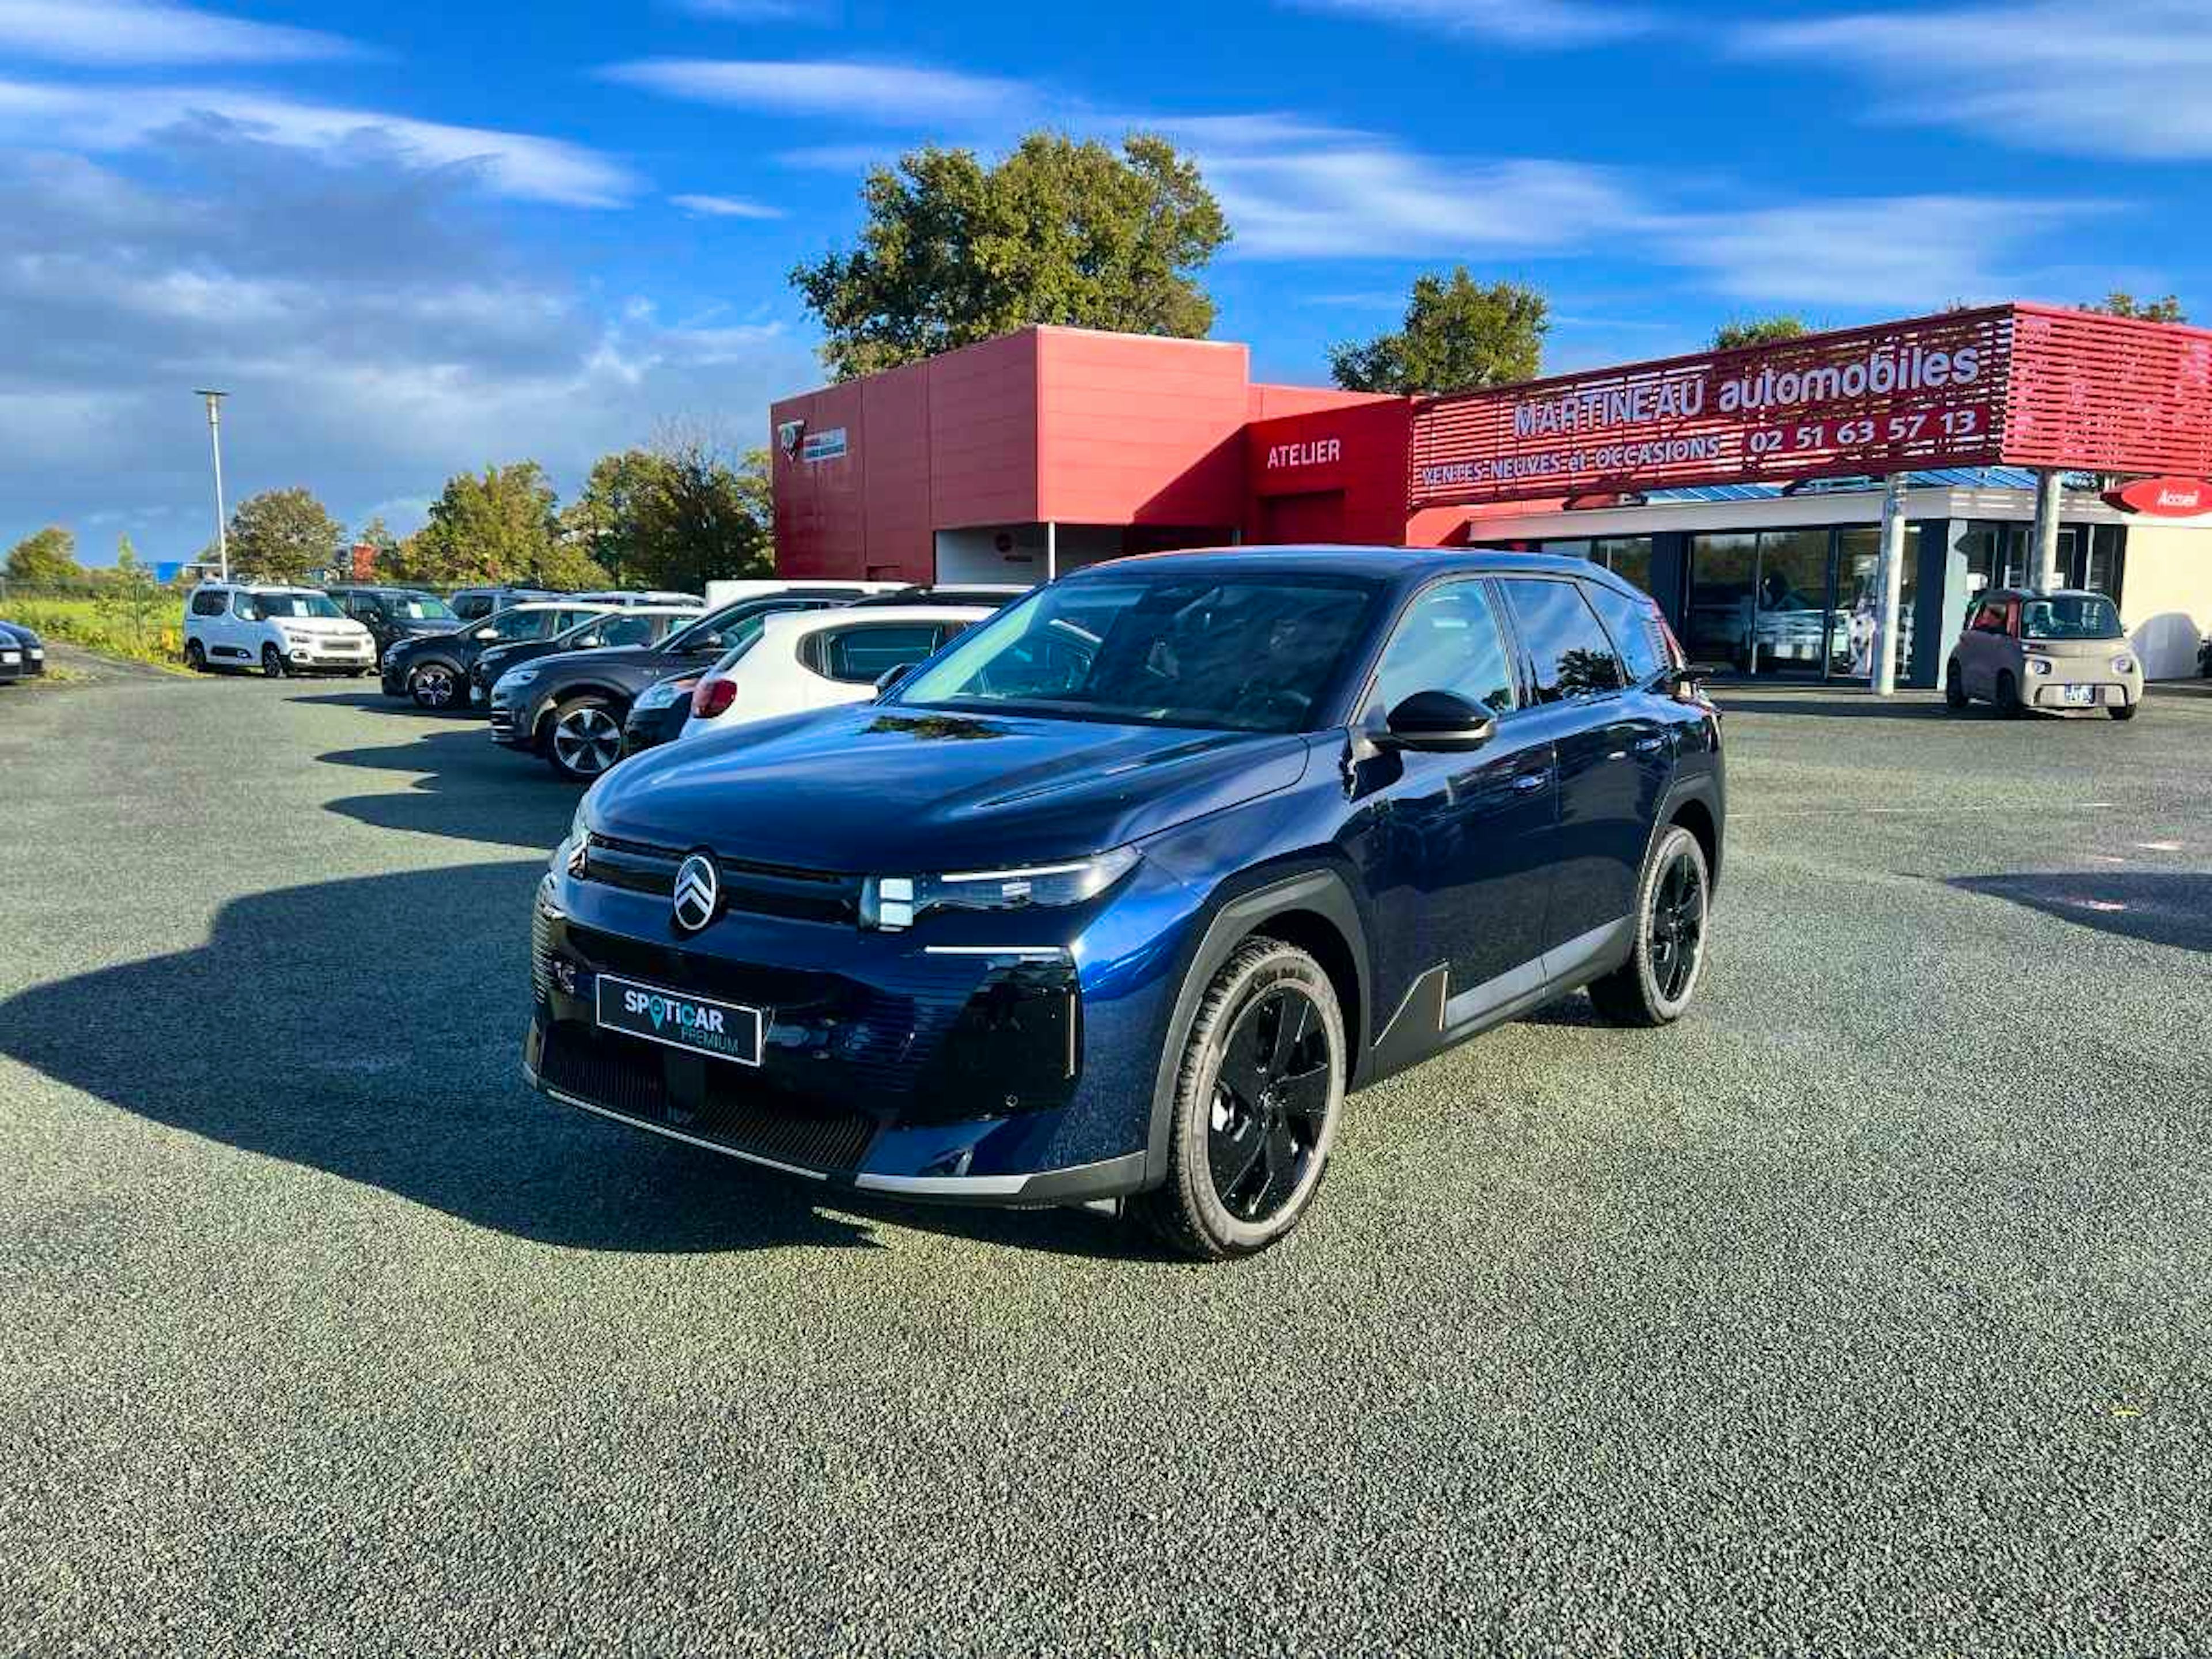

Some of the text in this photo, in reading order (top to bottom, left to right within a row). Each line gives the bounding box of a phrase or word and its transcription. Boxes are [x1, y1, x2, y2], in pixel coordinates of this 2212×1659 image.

[1513, 347, 1979, 437] MARTINEAU automobiles
[1749, 409, 1976, 453] 02 51 63 57 13
[1267, 438, 1341, 469] ATELIER
[1422, 435, 1720, 486] VENTES NEUVES et OCCASIONS
[624, 989, 724, 1034] SPOTICAR
[681, 1025, 738, 1054] PREMIUM
